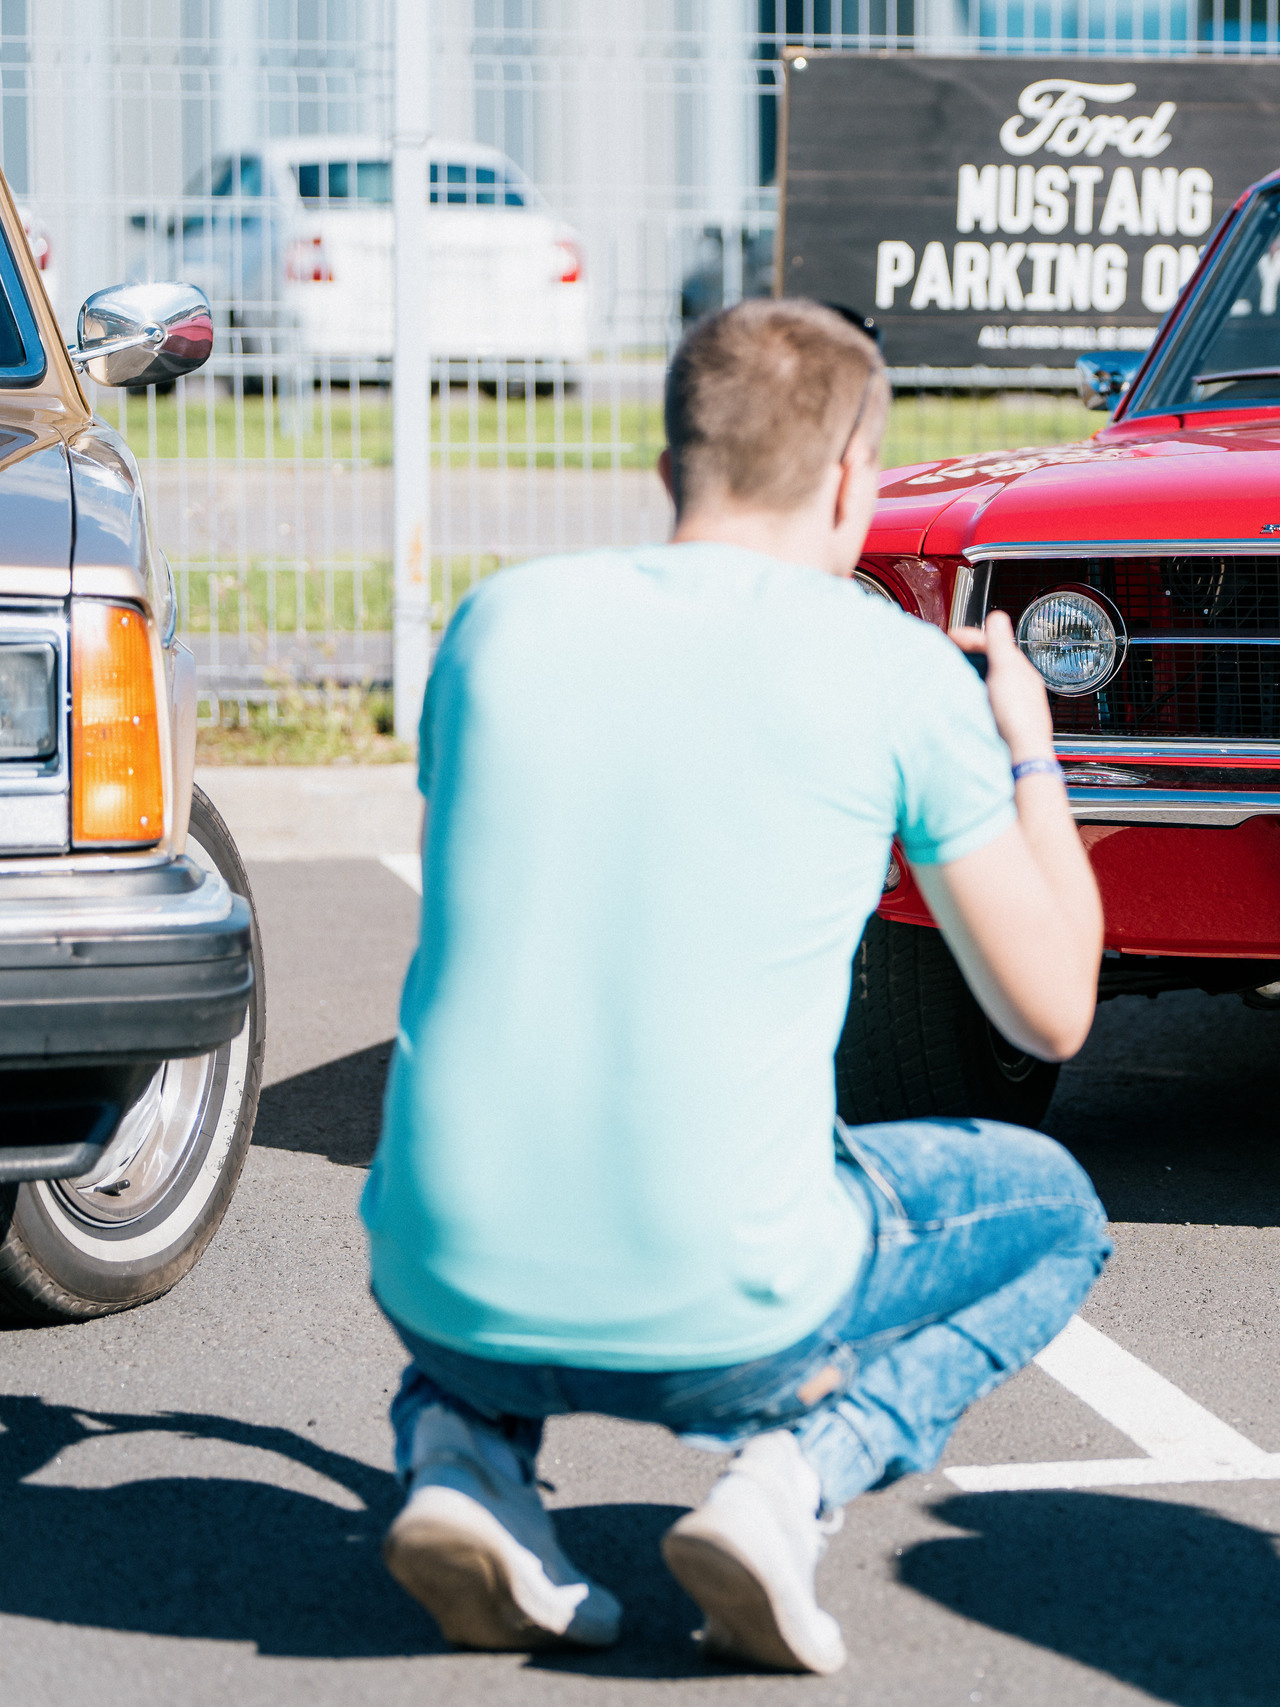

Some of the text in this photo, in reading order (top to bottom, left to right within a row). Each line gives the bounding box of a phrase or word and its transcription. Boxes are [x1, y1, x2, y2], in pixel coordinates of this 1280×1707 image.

[1000, 78, 1176, 158] Ford
[956, 163, 1214, 236] MUSTANG
[875, 240, 1129, 312] PARKING
